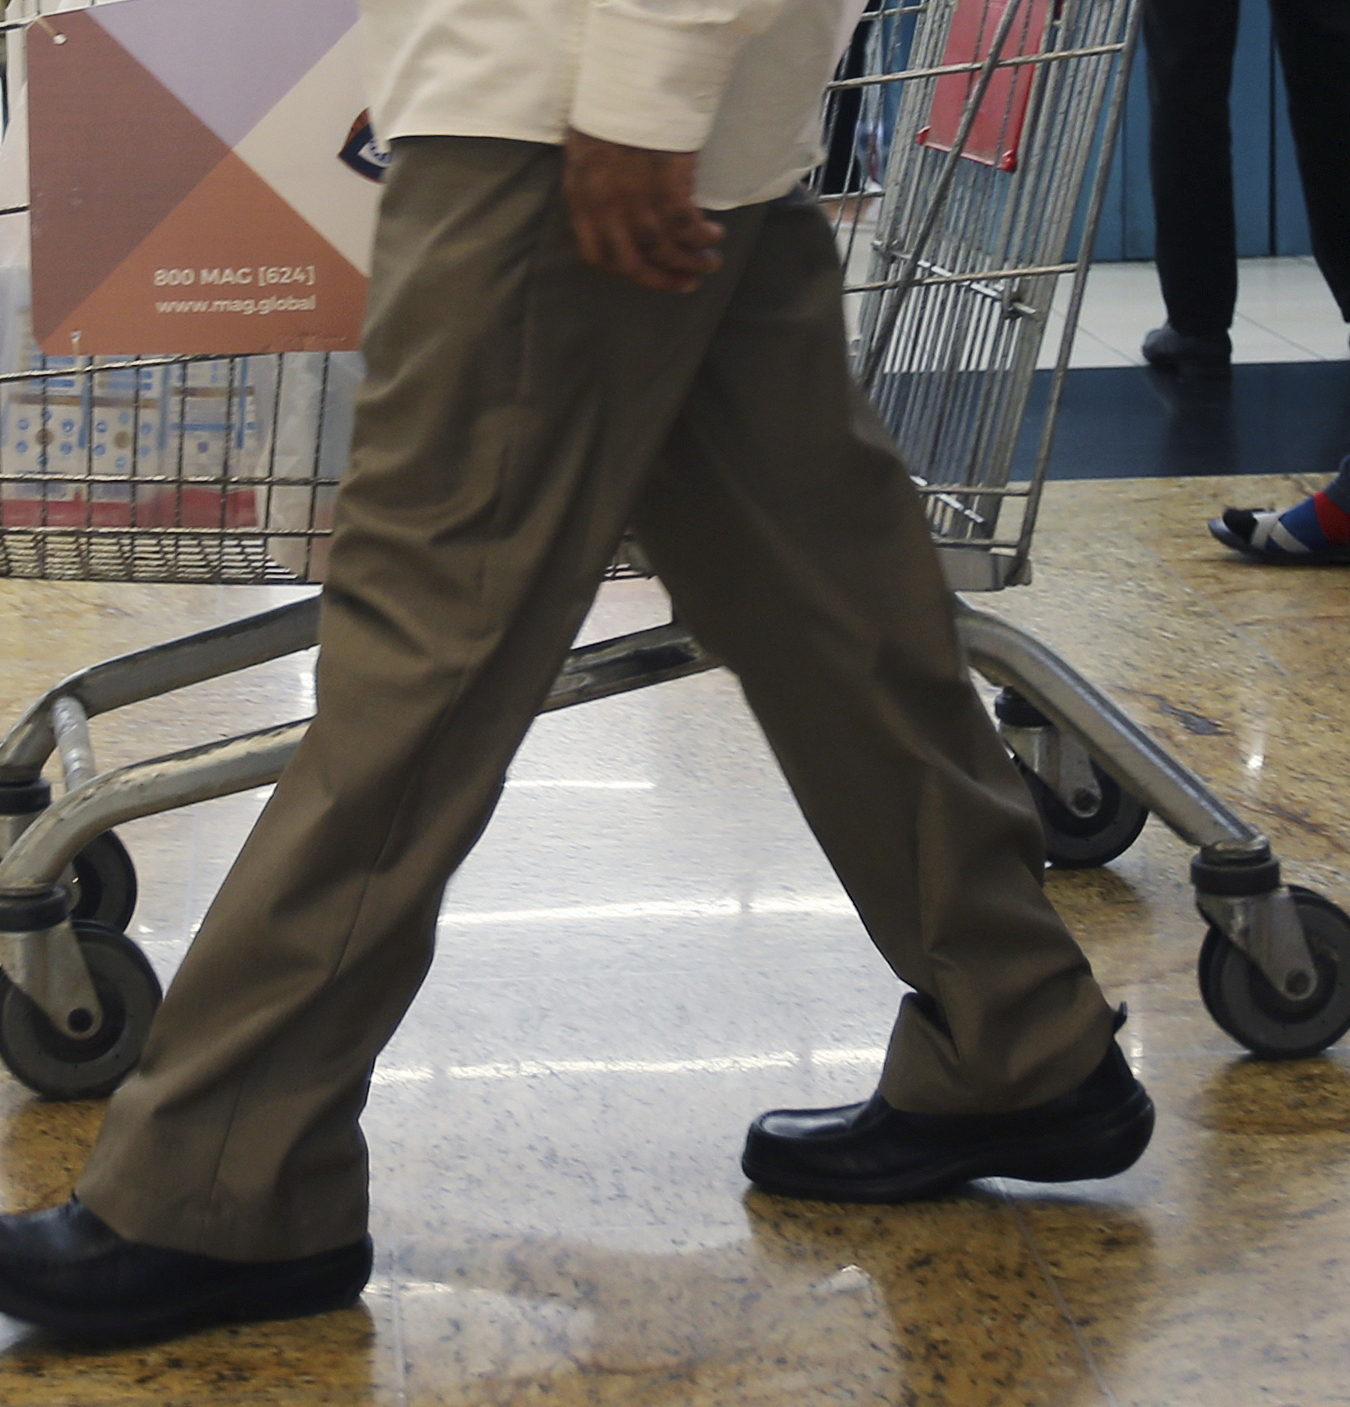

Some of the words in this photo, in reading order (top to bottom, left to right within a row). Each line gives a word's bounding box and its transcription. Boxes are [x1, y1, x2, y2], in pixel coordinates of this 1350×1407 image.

[153, 268, 196, 287] 800
[200, 267, 253, 286] MAG
[258, 265, 316, 287] [624]
[155, 294, 318, 315] www.mag.global
